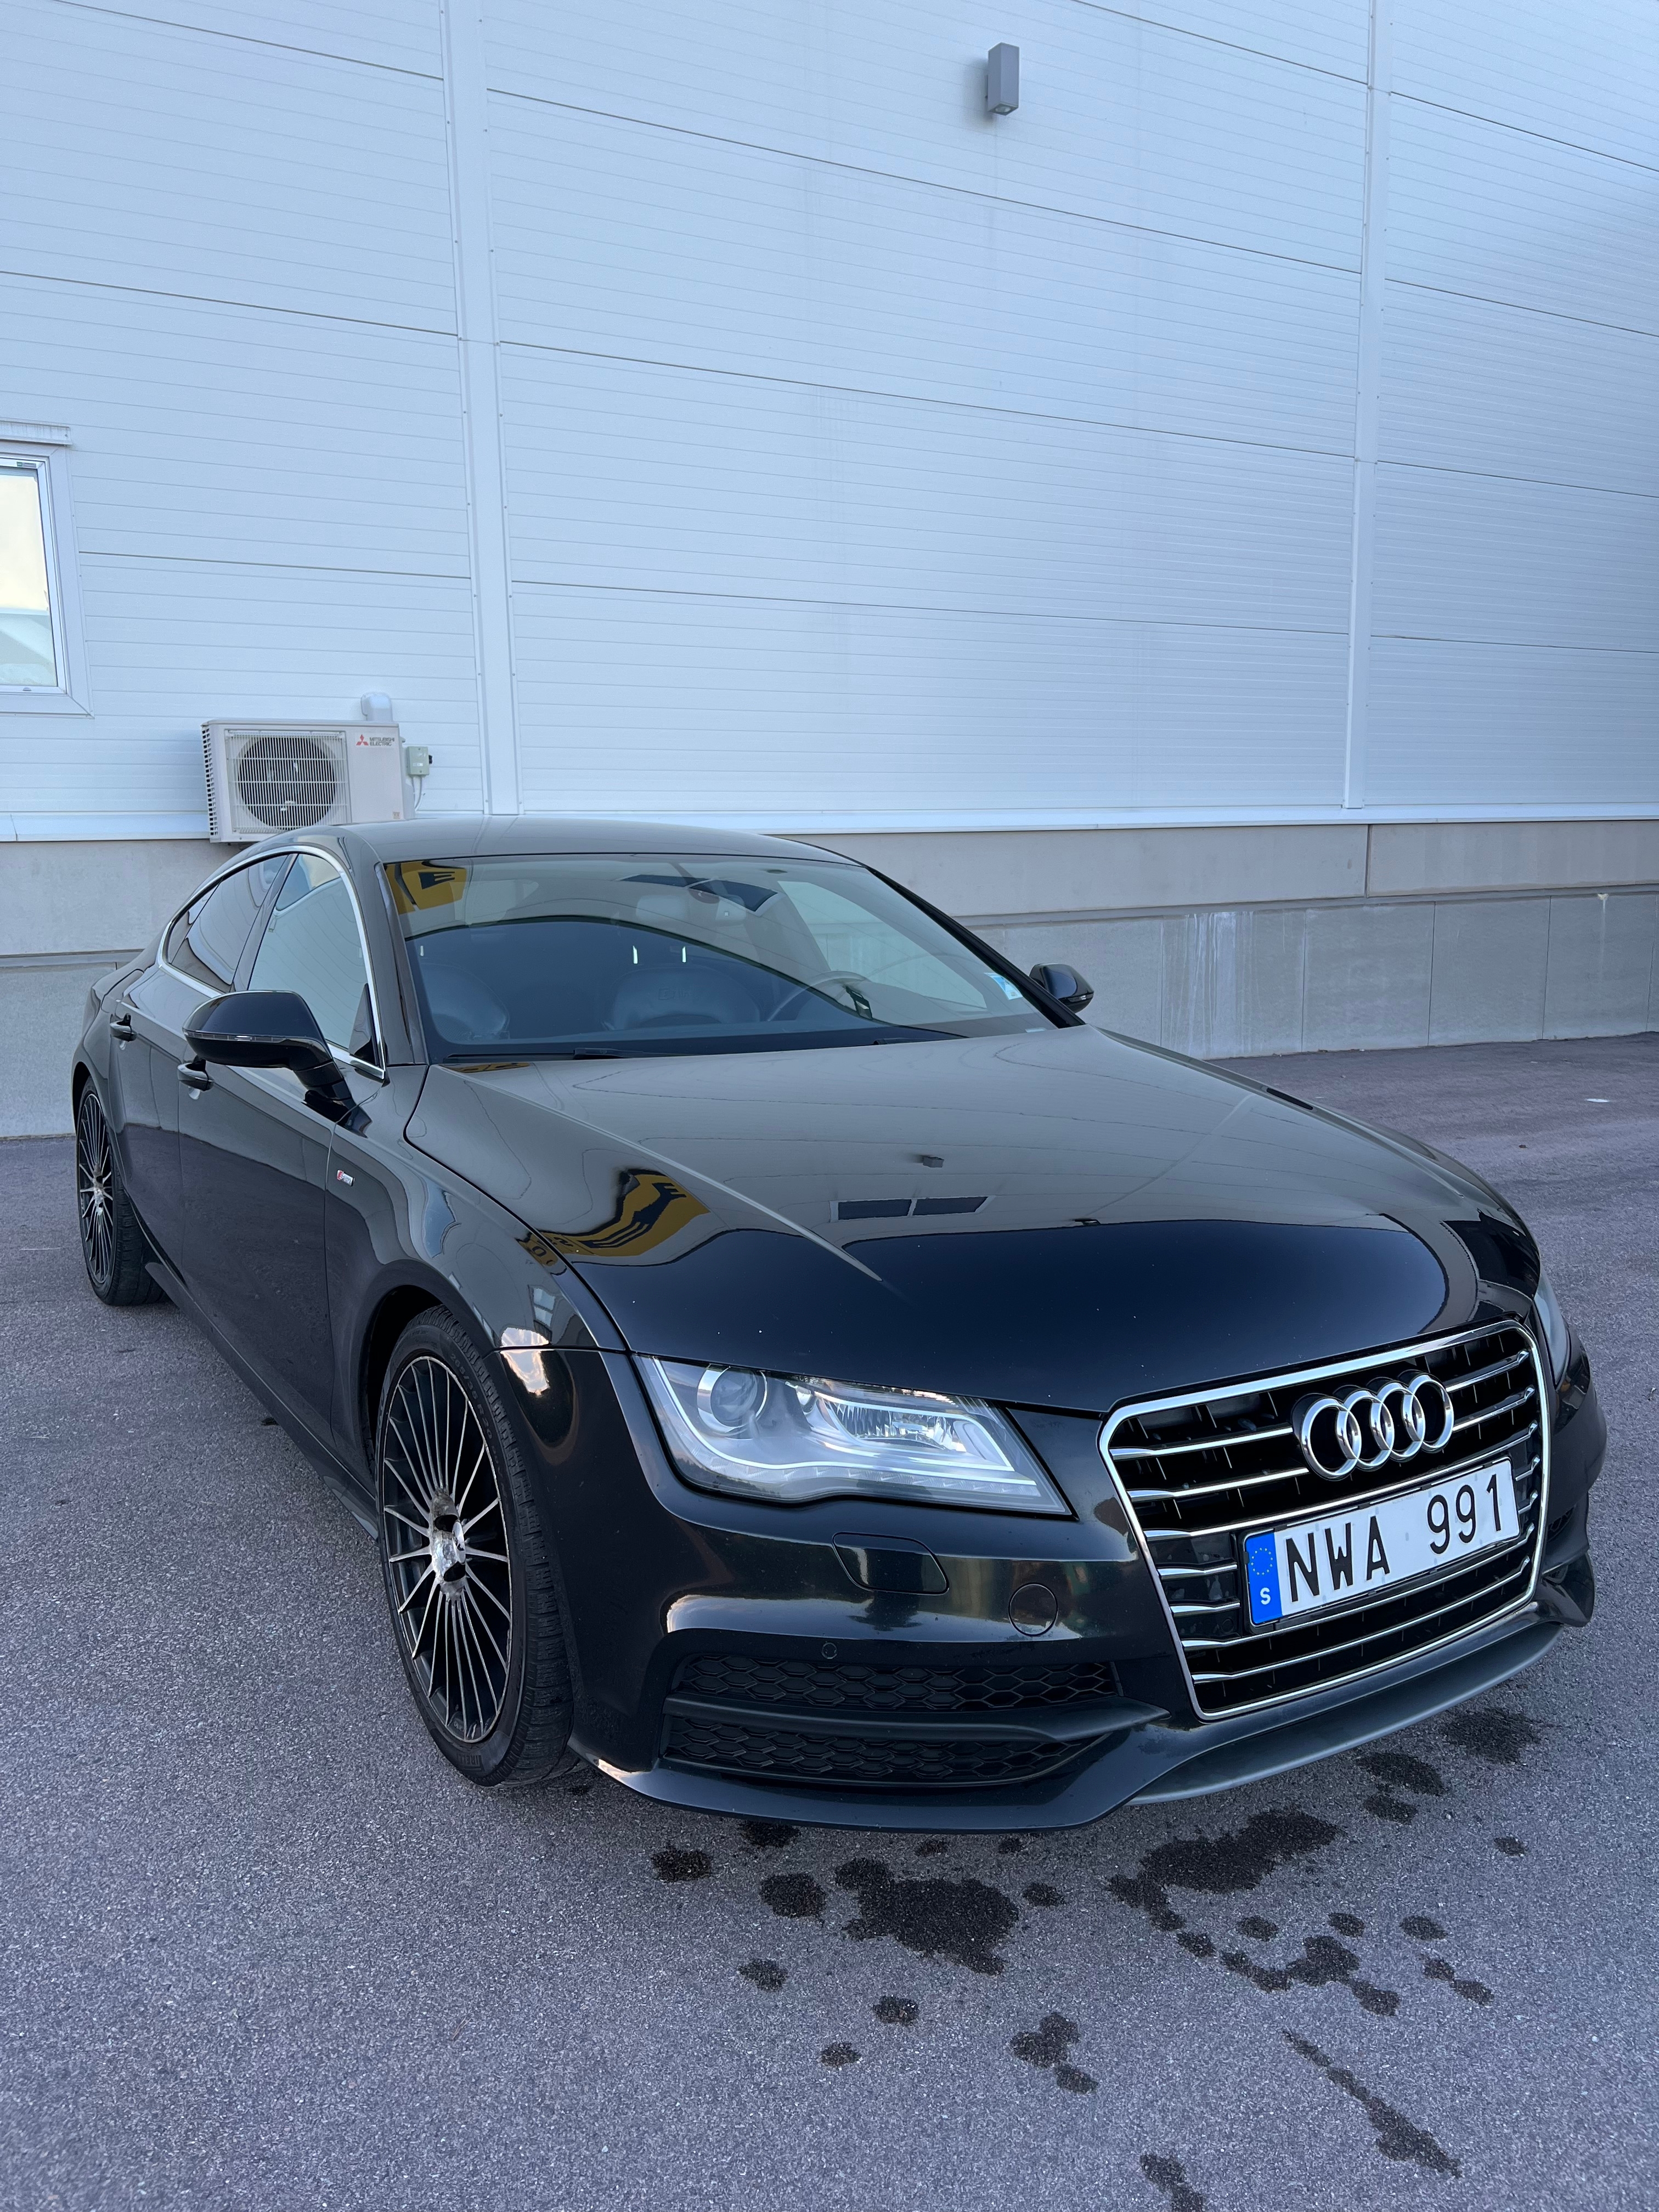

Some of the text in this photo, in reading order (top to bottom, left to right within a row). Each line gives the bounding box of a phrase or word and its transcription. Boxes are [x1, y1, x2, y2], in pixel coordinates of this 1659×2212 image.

[1285, 1474, 1502, 1603] NWA 991
[1259, 1587, 1271, 1605] S
